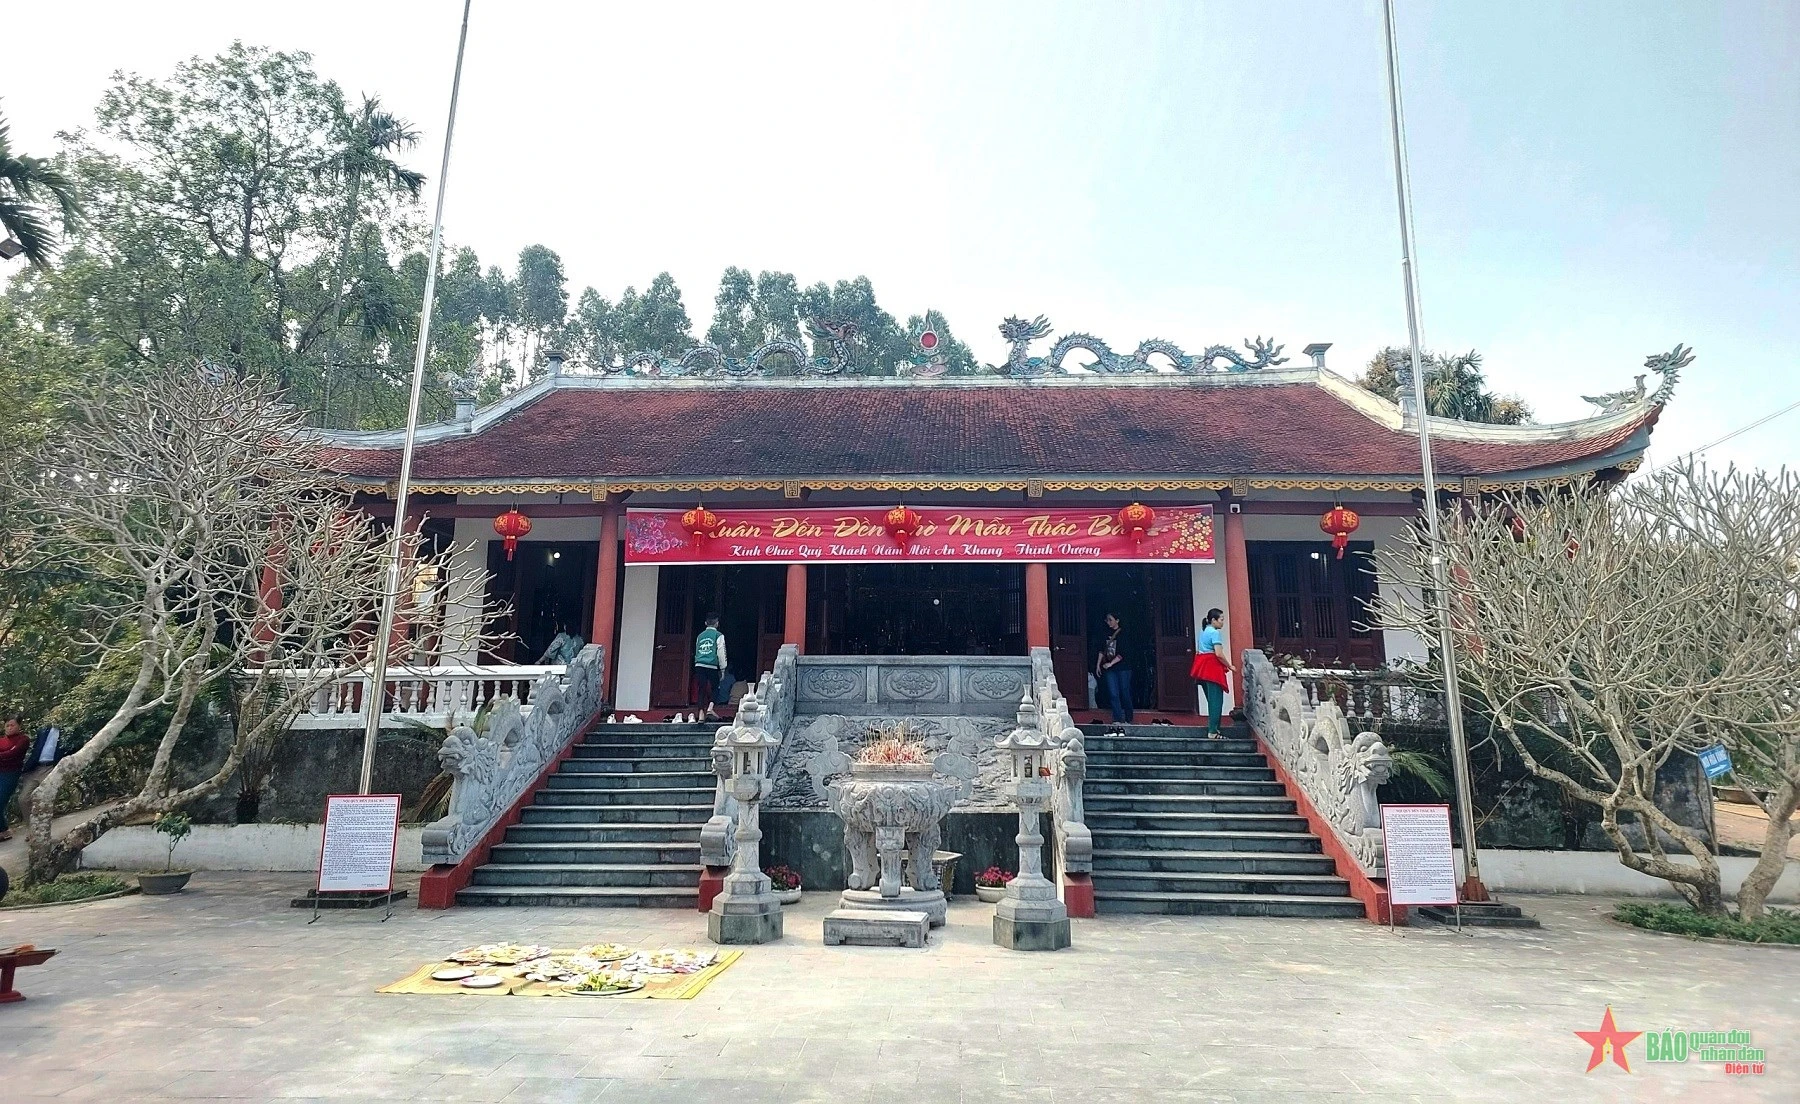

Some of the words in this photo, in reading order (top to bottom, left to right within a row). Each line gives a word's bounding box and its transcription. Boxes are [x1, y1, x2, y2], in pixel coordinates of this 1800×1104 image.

[771, 517, 824, 538] Đến
[832, 516, 885, 538] Đền
[945, 514, 1013, 537] Mẫu
[1022, 515, 1080, 538] Thác
[798, 544, 823, 558] Quý
[826, 544, 868, 556] Khách
[934, 544, 956, 556] An
[958, 543, 1004, 558] Khang
[1014, 543, 1054, 558] Thịnh
[1057, 543, 1102, 557] Vượng
